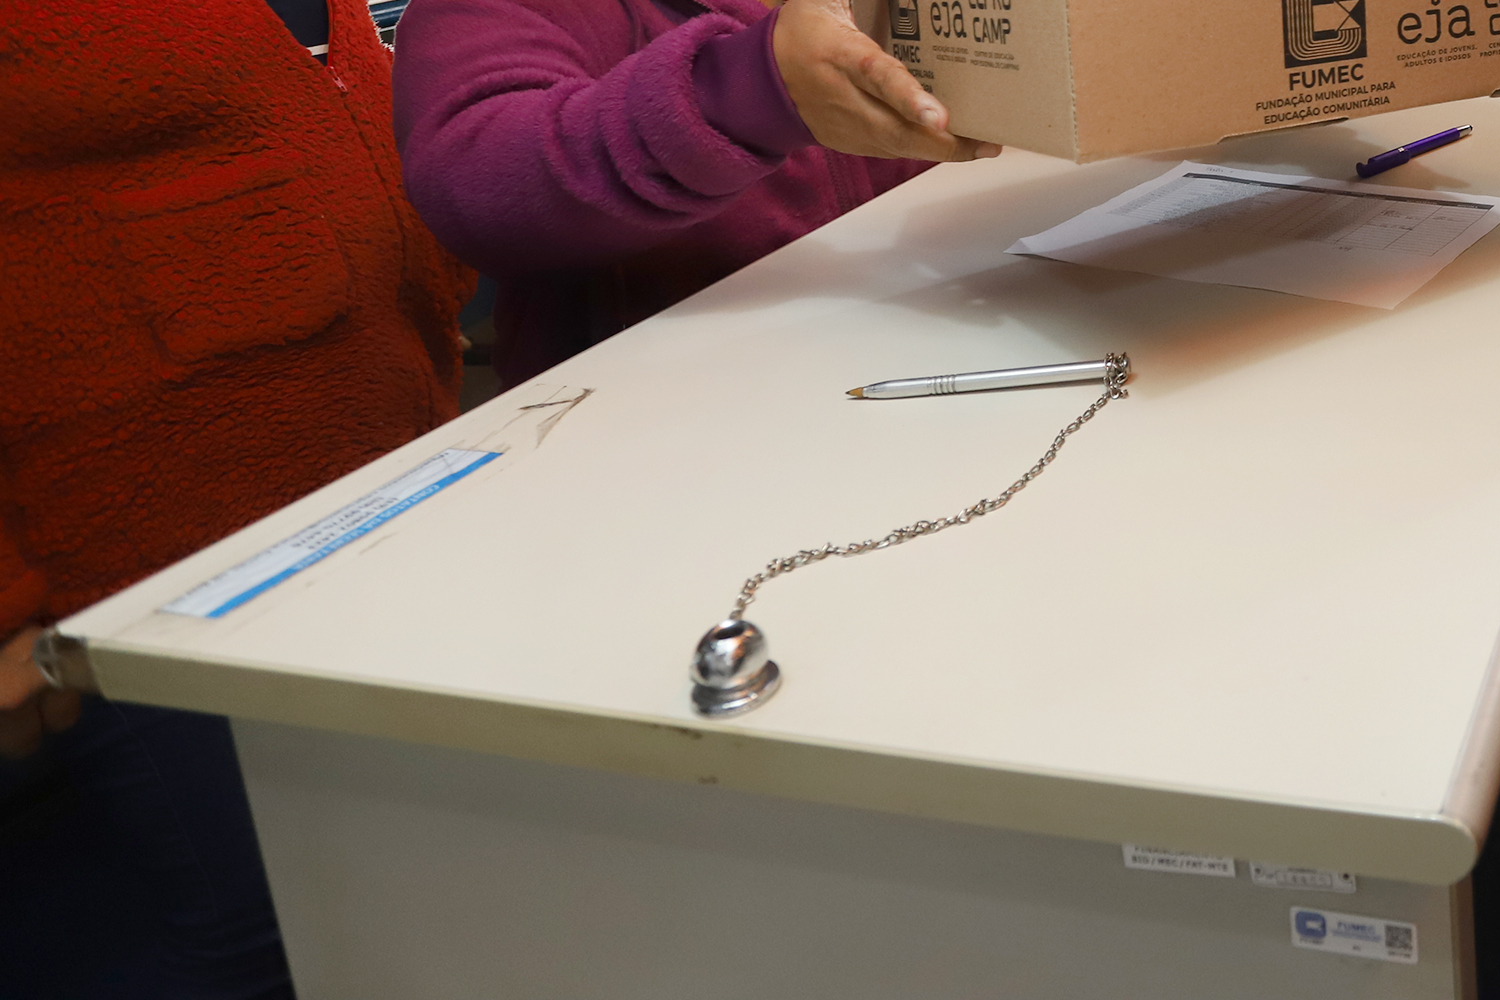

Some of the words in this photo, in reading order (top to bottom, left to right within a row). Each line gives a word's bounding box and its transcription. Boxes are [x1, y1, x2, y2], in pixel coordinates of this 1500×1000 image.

[973, 17, 1011, 44] CAMP
[1396, 49, 1437, 61] EDUCAÇÃO
[1404, 58, 1437, 68] ADULTOS
[1445, 53, 1472, 62] IDOSOS
[1289, 63, 1365, 91] FUMEC
[1256, 93, 1313, 111] FUNDAÇÃO
[1315, 86, 1369, 102] MUNICIPAL
[1371, 81, 1396, 93] PARA
[1264, 107, 1321, 125] EDUCAÇÃO
[1324, 96, 1390, 115] COMUNITÁRIA
